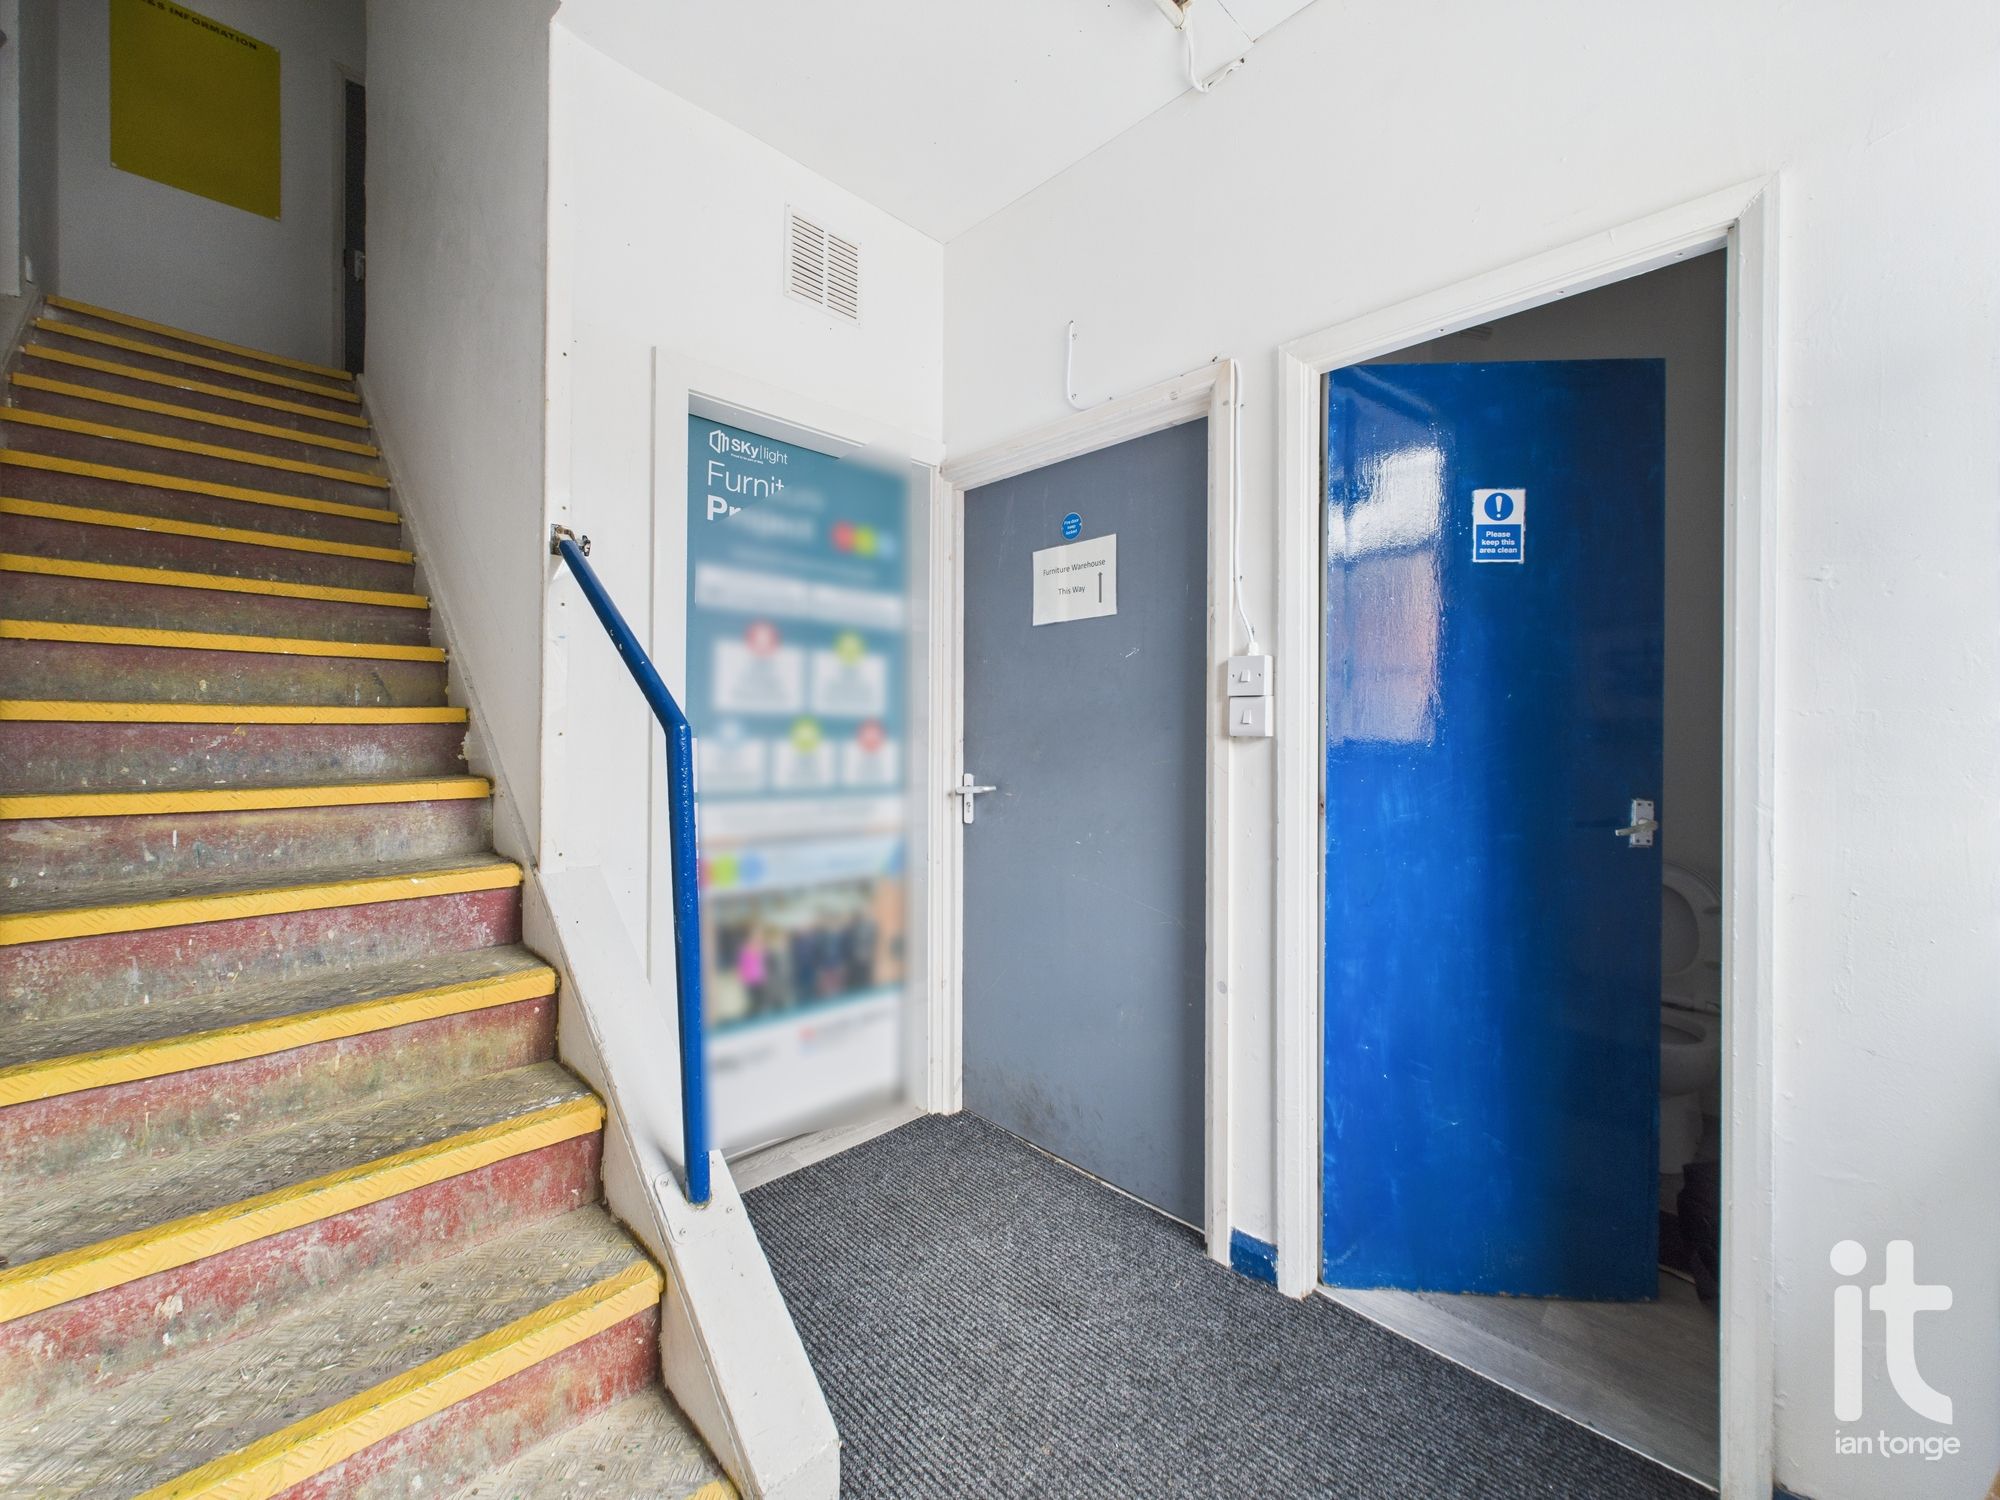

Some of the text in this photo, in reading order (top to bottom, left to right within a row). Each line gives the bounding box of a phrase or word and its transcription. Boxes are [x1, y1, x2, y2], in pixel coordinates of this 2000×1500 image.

[170, 7, 257, 50] INFORMATION
[707, 460, 789, 498] Furnit
[1043, 559, 1106, 576] Furniture Warehouse
